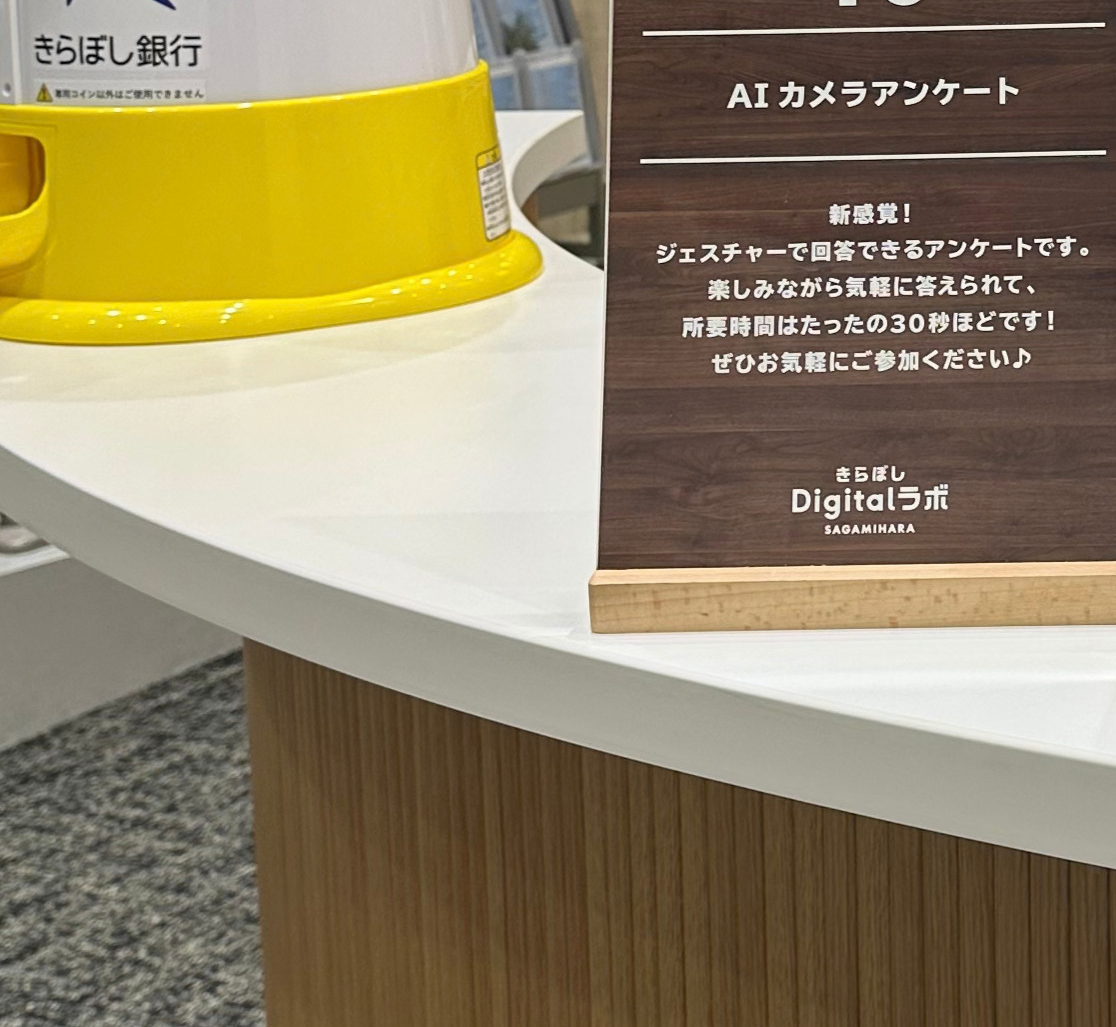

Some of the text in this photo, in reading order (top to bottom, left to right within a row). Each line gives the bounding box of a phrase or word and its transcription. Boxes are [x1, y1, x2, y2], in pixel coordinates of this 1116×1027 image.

[34, 34, 202, 67] きらぼし銀行
[707, 274, 1036, 301] 楽しみながら気軽に答えられて、
[835, 464, 906, 483] きらぼし
[824, 523, 916, 535] SAGAMIHARA
